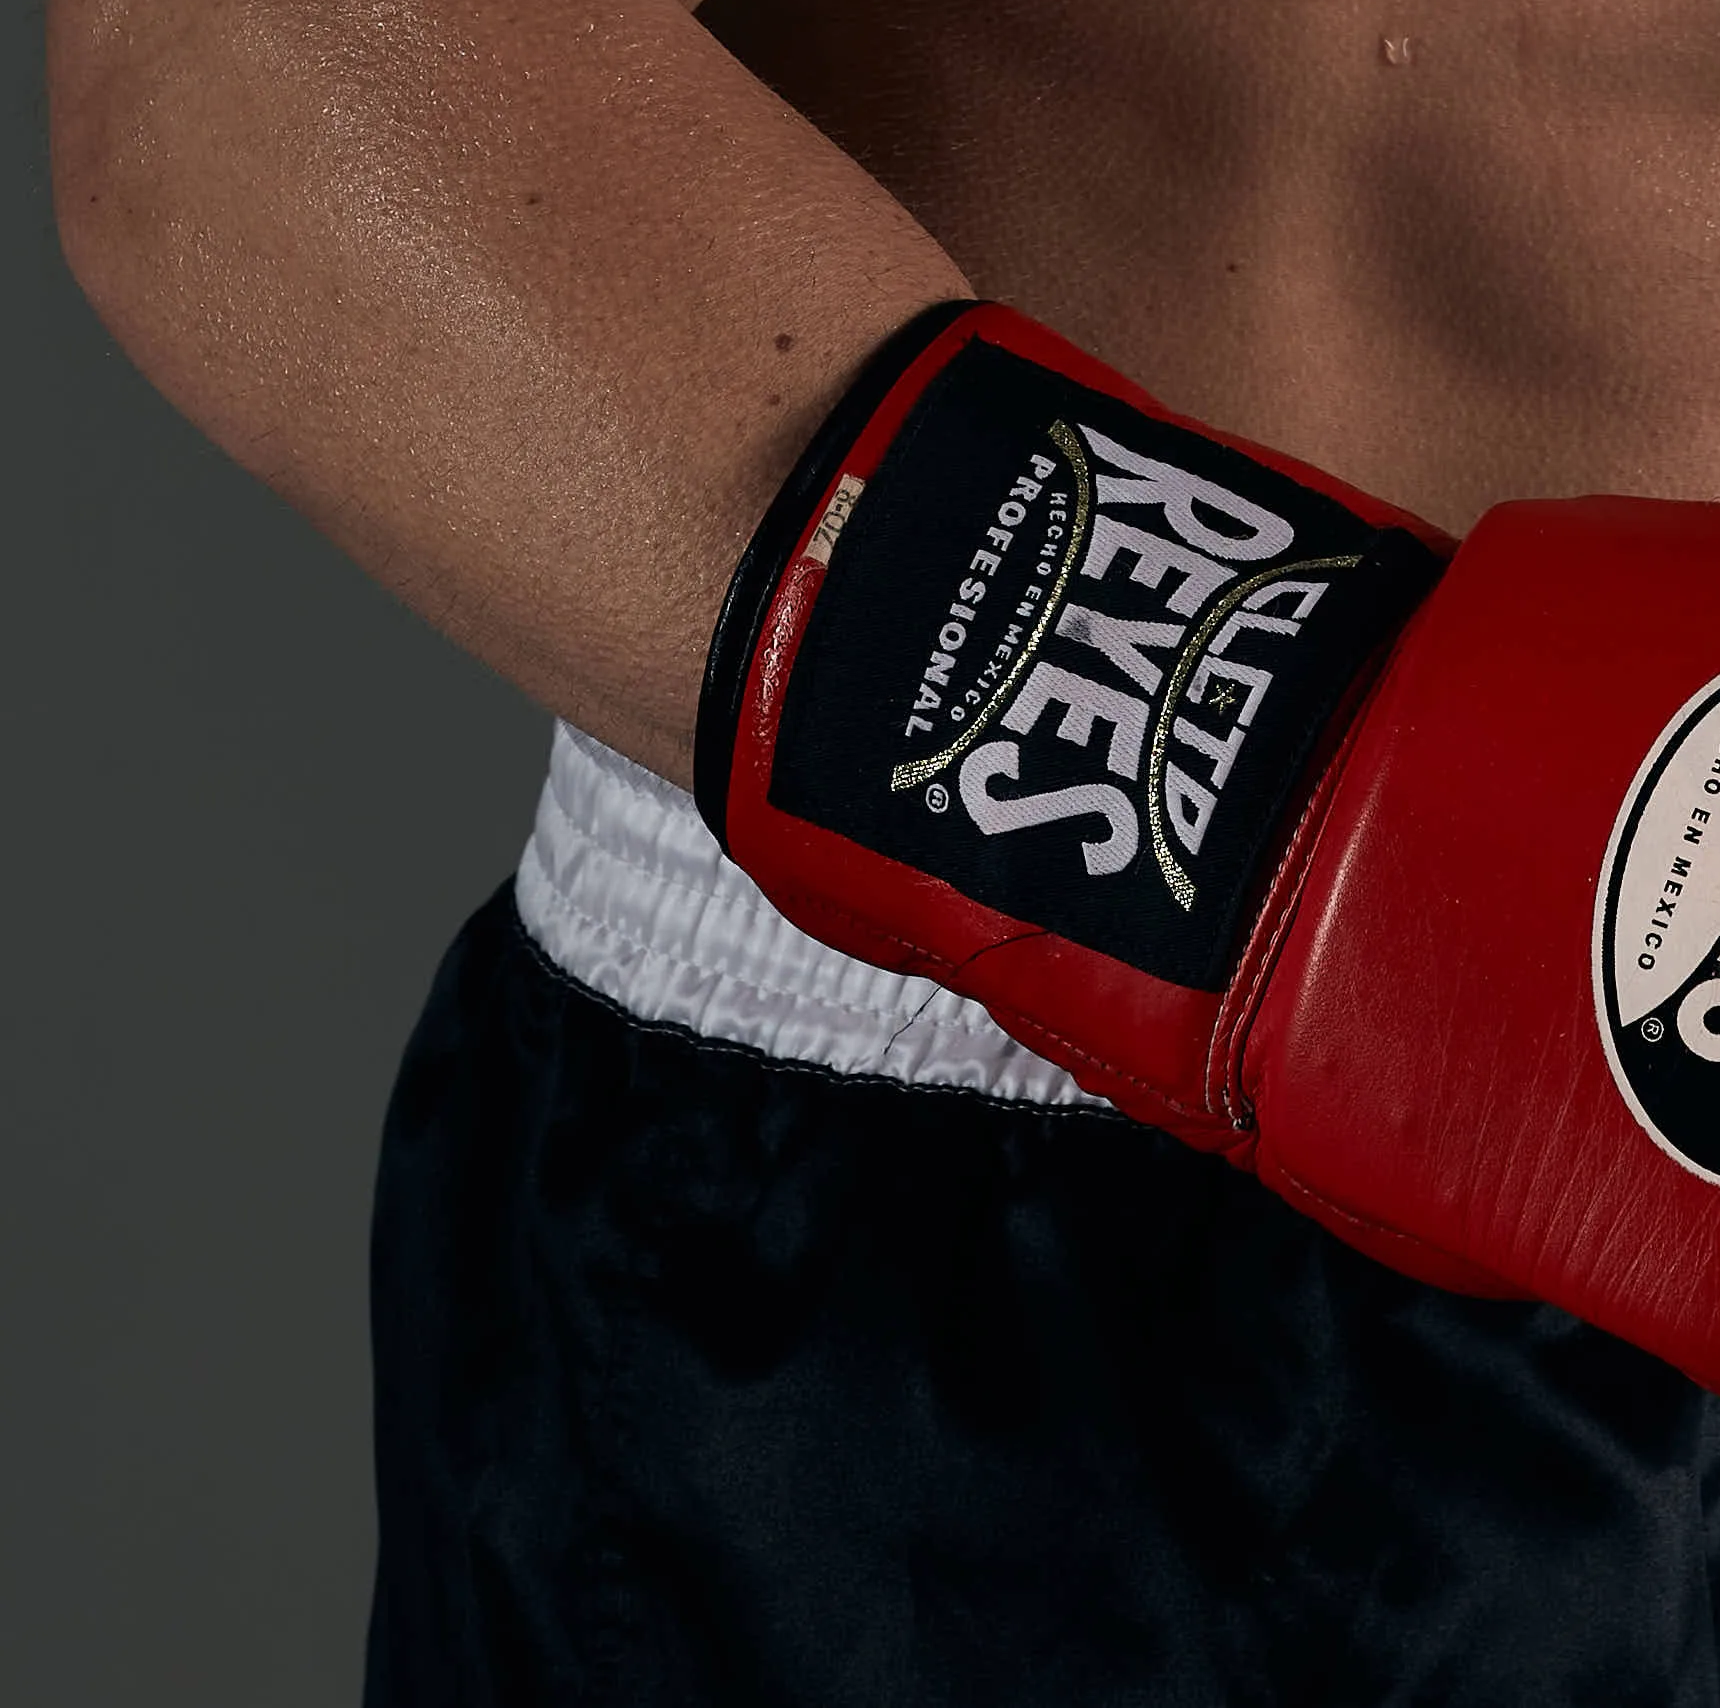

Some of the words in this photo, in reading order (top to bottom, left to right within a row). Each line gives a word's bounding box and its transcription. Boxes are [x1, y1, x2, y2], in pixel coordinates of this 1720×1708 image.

[1035, 492, 1068, 576] HECHO
[904, 454, 1057, 737] PROFESIONAL
[1015, 584, 1043, 617] EN
[950, 623, 1024, 722] MEXICO
[959, 424, 1295, 876] REYES
[1683, 807, 1711, 845] EN
[1637, 856, 1692, 970] MEXICO
